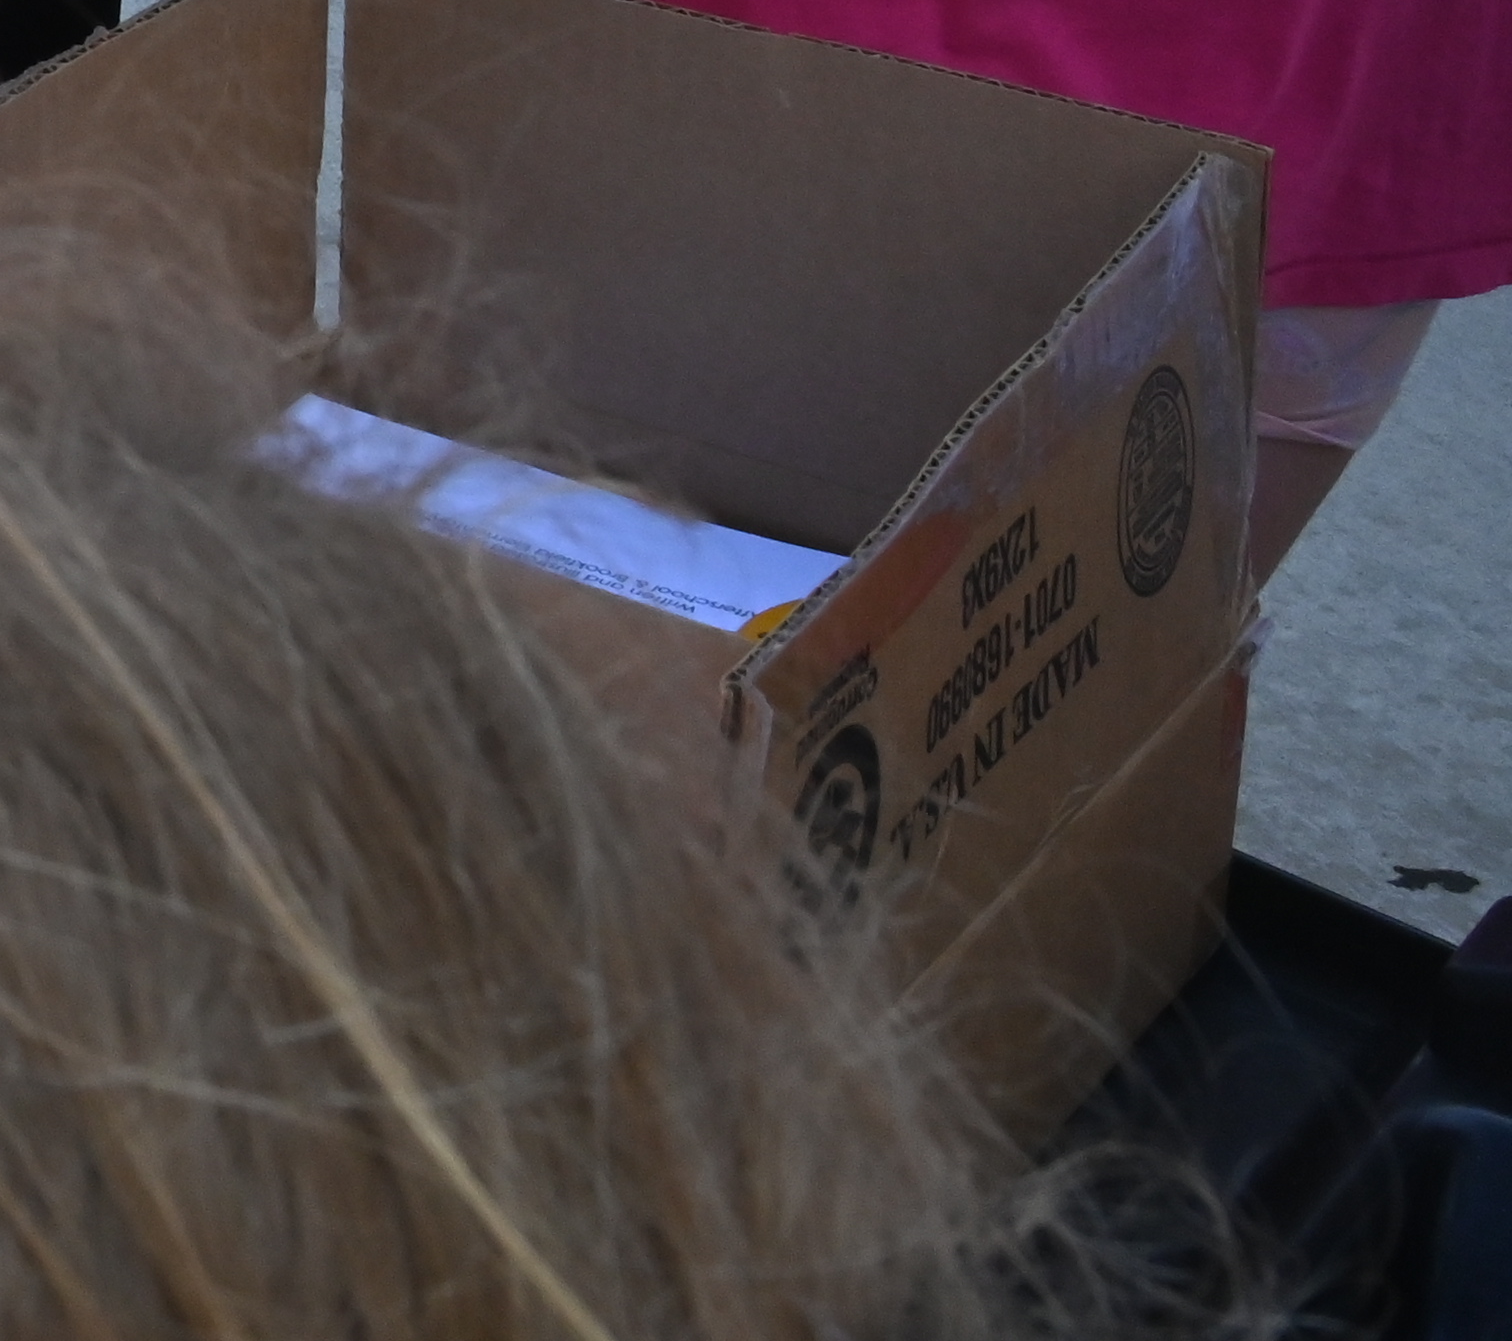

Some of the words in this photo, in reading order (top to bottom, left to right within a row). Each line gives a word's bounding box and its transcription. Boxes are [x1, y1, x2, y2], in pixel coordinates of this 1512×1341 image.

[533, 547, 629, 583] Brookfield
[584, 573, 625, 591] and
[635, 578, 650, 589] &
[629, 587, 696, 614] Written
[1013, 614, 1101, 746] MADE
[972, 706, 1006, 788] IN
